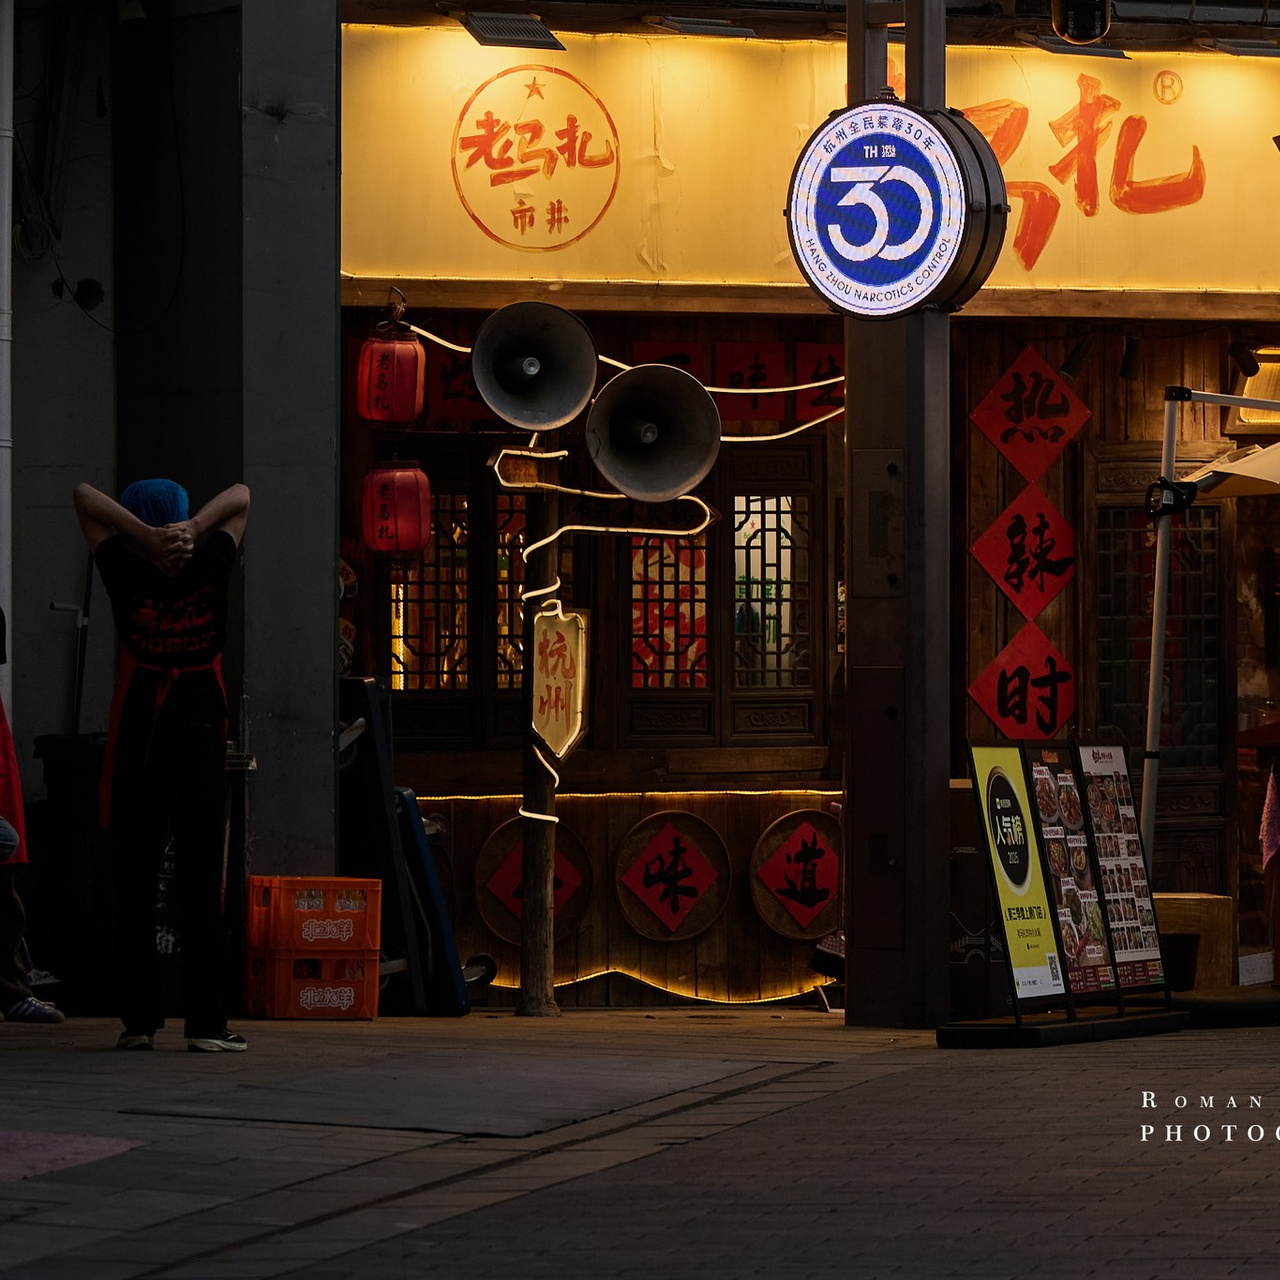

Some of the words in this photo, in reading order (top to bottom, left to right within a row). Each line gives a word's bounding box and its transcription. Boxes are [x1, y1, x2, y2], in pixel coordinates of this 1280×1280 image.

[459, 109, 616, 187] 老马扎
[863, 145, 878, 159] TH
[510, 200, 569, 236] 市井
[827, 165, 933, 262] 30
[806, 238, 827, 272] HANG
[826, 271, 851, 296] ZHOU
[854, 282, 914, 302] NARCOTICS
[915, 237, 951, 286] CONTROL
[373, 352, 391, 411] 老马扎
[377, 483, 394, 540] 老马扎
[538, 629, 577, 730] 杭州
[302, 919, 354, 942] 北冰洋
[300, 987, 354, 1010] 北冰洋
